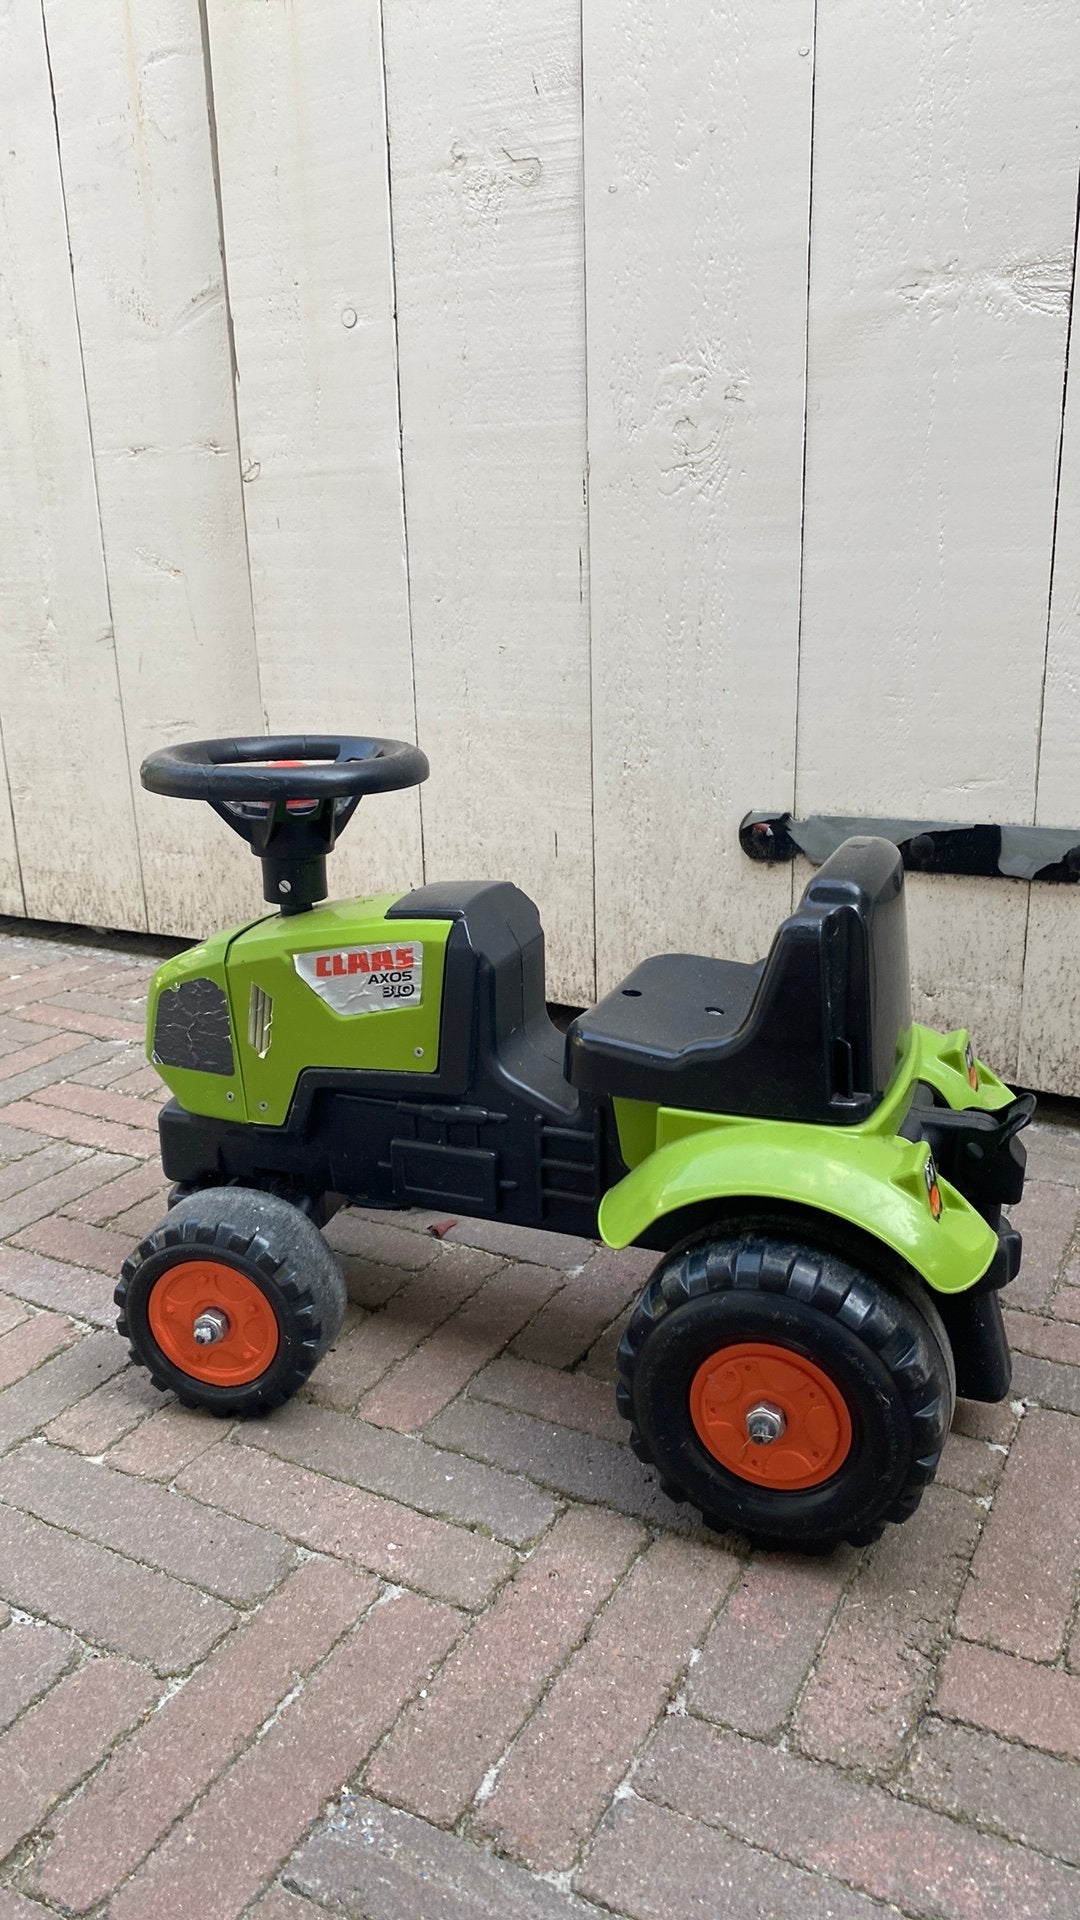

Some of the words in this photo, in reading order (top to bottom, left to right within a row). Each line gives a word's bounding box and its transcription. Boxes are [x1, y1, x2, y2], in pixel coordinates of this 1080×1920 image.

[316, 948, 414, 977] CLAAS
[368, 971, 412, 984] AXOS
[383, 984, 415, 998] 310
